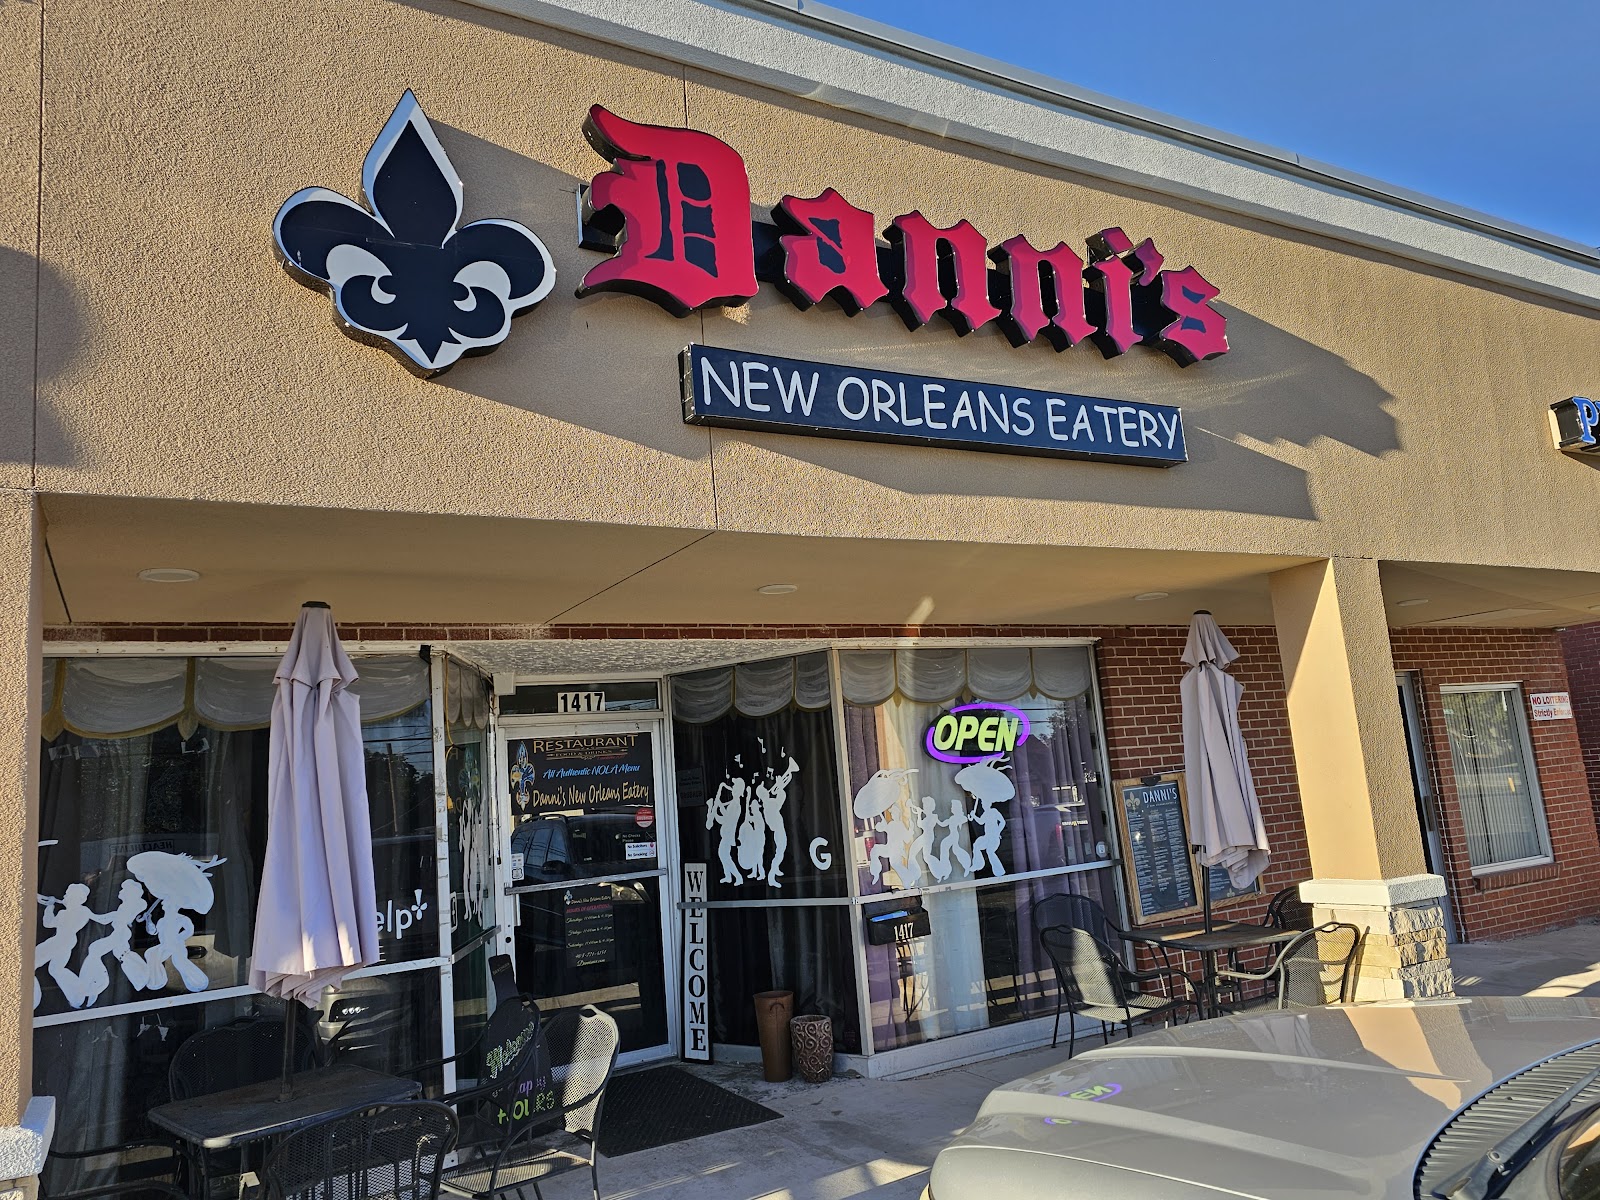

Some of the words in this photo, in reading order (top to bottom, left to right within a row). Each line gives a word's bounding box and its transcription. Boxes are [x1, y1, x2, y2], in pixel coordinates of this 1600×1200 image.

[575, 104, 1229, 361] Danni's
[701, 357, 819, 416] NEW
[837, 376, 1035, 437] ORLEANS
[1046, 398, 1180, 450] EATERY
[560, 692, 604, 712] 1417
[1532, 696, 1541, 704] NO
[1534, 708, 1553, 718] Strictly
[933, 714, 1019, 752] OPEN
[533, 734, 639, 754] RESTAURANT
[591, 764, 618, 776] NOLA
[533, 786, 566, 808] Danni's
[568, 784, 587, 806] New
[588, 783, 621, 804] Orleans
[622, 782, 649, 803] Eatery
[1142, 788, 1178, 804] DANNI'S
[377, 899, 413, 940] elp
[894, 922, 914, 942] 1417
[686, 870, 706, 1052] WELCOME
